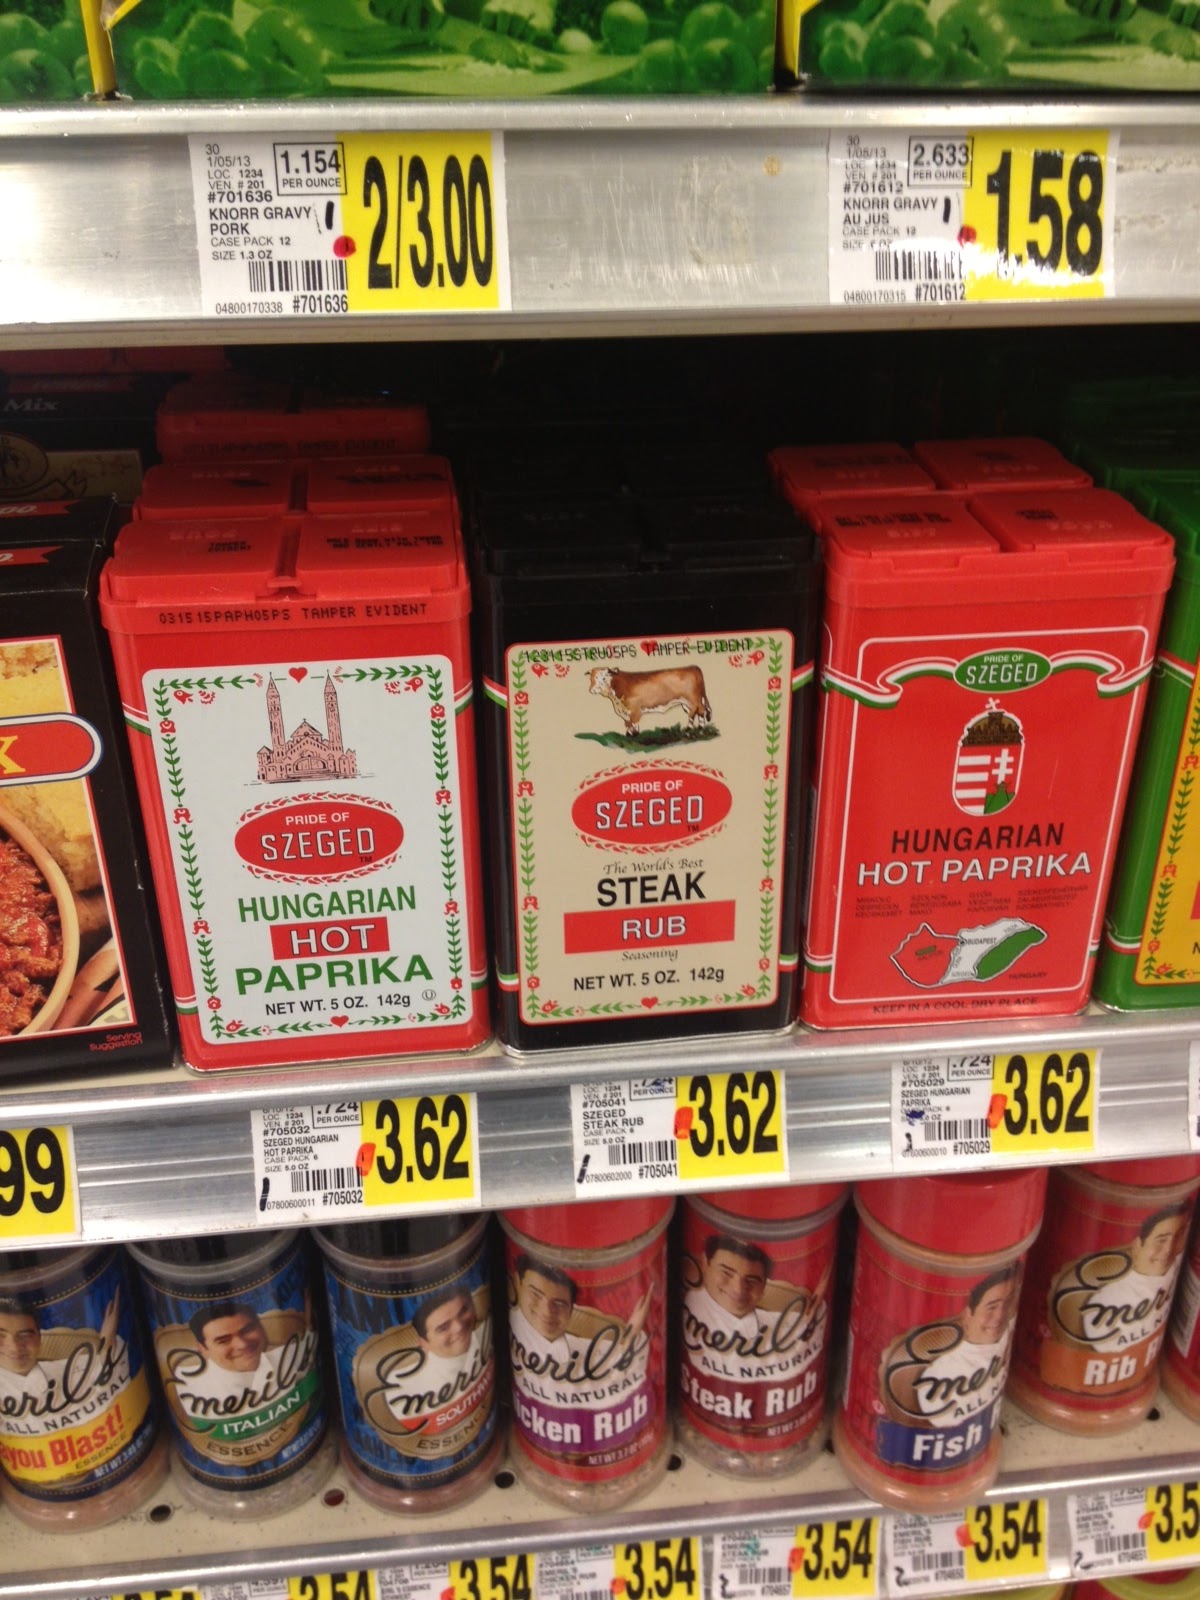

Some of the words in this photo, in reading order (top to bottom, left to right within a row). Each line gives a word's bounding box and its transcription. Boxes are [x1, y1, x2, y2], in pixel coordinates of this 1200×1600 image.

[205, 144, 220, 155] 30
[913, 143, 970, 167] 2.633
[207, 156, 251, 167] 1/05/13
[280, 150, 341, 174] 1.154
[238, 169, 263, 178] 1234
[913, 171, 932, 180] PER
[934, 170, 967, 180] OUNCE
[247, 180, 265, 189] 201
[282, 179, 303, 188] PER
[305, 177, 341, 188] OUNCE
[843, 182, 904, 194] #701612
[207, 191, 273, 203] #701636
[843, 199, 890, 211] KNORR
[893, 198, 938, 210] GRAVY
[209, 207, 260, 221] KNORR
[263, 206, 311, 220] GRAVY
[363, 154, 493, 289] 2/3.00
[843, 213, 861, 225] AU
[865, 213, 889, 225] JUS
[987, 150, 1104, 278] 1.58
[210, 223, 250, 235] PORK
[842, 227, 870, 236] CASE
[873, 226, 900, 236] PACK
[211, 237, 237, 247] CASE
[240, 237, 274, 246] PACK
[279, 237, 291, 246] 12
[212, 251, 236, 260] SIZE
[240, 250, 255, 260] 1.3
[257, 250, 272, 260] OZ
[915, 283, 966, 301] #701612
[215, 302, 283, 315] 04800170338
[293, 296, 348, 313] #701636
[301, 605, 356, 621] TAMPER
[365, 602, 429, 618] EVIDENT
[644, 641, 690, 657] TAMPER
[983, 654, 1009, 664] PRIDE
[1011, 653, 1024, 662] OF
[965, 663, 1038, 685] SZEGED
[622, 781, 662, 794] PRIDE
[665, 780, 683, 792] OF
[285, 814, 327, 826] PRIDE
[330, 812, 350, 823] OF
[595, 795, 704, 831] SZEGED
[260, 826, 376, 862] SZEGED
[891, 823, 1065, 853] HUNGARIAN
[603, 863, 628, 875] The
[631, 859, 676, 873] World's
[678, 857, 704, 870] Best
[857, 860, 933, 887] HOT
[941, 852, 1092, 882] PAPRIKA
[597, 871, 707, 907] STEAK
[238, 885, 417, 923] HUNGARIAN
[621, 915, 687, 941] RUB
[289, 924, 376, 955] HOT
[967, 937, 998, 945] BUDAPEST
[621, 947, 679, 962] Seasoning
[235, 954, 433, 996] PAPRIKA
[573, 976, 604, 992] NET
[610, 973, 637, 989] WT.
[641, 972, 650, 986] 5
[654, 969, 681, 985] OZ.
[688, 967, 725, 984] 142g
[265, 1002, 297, 1016] NET
[299, 999, 328, 1014] WT.
[329, 998, 339, 1011] 5
[342, 995, 368, 1010] OZ.
[376, 993, 411, 1009] 142g
[873, 1004, 906, 1014] KEEP
[921, 1003, 930, 1011] A
[934, 1001, 967, 1010] COOL
[999, 997, 1038, 1006] PLACE
[89, 1039, 143, 1051] Suggestion
[106, 1032, 142, 1042] Serving
[951, 1069, 966, 1077] PER
[968, 1068, 991, 1076] OUNCE
[650, 1087, 674, 1095] OUNCE
[902, 1079, 945, 1088] #705029
[901, 1089, 929, 1098] SZEGED
[929, 1087, 971, 1096] HUNGARIAN
[1005, 1052, 1090, 1135] 3.62
[582, 1098, 626, 1108] #705041
[901, 1099, 931, 1107] PAPRIKA
[316, 1116, 333, 1124] PER
[334, 1114, 359, 1122] OUNCE
[582, 1109, 626, 1120] SZEGED
[689, 1070, 778, 1158] 3.62
[263, 1126, 310, 1136] #705032
[583, 1119, 619, 1130] STEAK
[622, 1118, 644, 1126] RUB
[263, 1138, 293, 1147] SZEGED
[295, 1134, 339, 1145] HUNGARIAN
[375, 1094, 470, 1184] 3.62
[584, 1138, 600, 1146] SIZE
[264, 1148, 280, 1156] HOT
[281, 1146, 314, 1156] PAPRIKA
[953, 1141, 991, 1155] #705029
[639, 1163, 678, 1179] #705041
[322, 1191, 363, 1206] #705032
[1117, 1329, 1149, 1345] ALL
[701, 1356, 733, 1377] ALL
[740, 1342, 824, 1379] NATURAL
[1083, 1355, 1137, 1386] Rib
[522, 1381, 550, 1399] ALL
[555, 1372, 644, 1404] NATURAL
[681, 1362, 753, 1419] Steak
[766, 1370, 817, 1417] Rub
[5, 1423, 39, 1434] ALL
[44, 1374, 130, 1432] NATURAL
[954, 1398, 985, 1418] ALL
[222, 1391, 301, 1435] ITALIAN
[594, 1392, 648, 1441] Rub
[49, 1404, 124, 1466] Blast!
[206, 1423, 292, 1458] ESSENCE
[912, 1422, 981, 1461] Fish
[75, 1432, 128, 1470] ESSENCE
[974, 1500, 1041, 1562] 3.54
[804, 1518, 872, 1580] 3.54
[623, 1538, 696, 1600] 3.54
